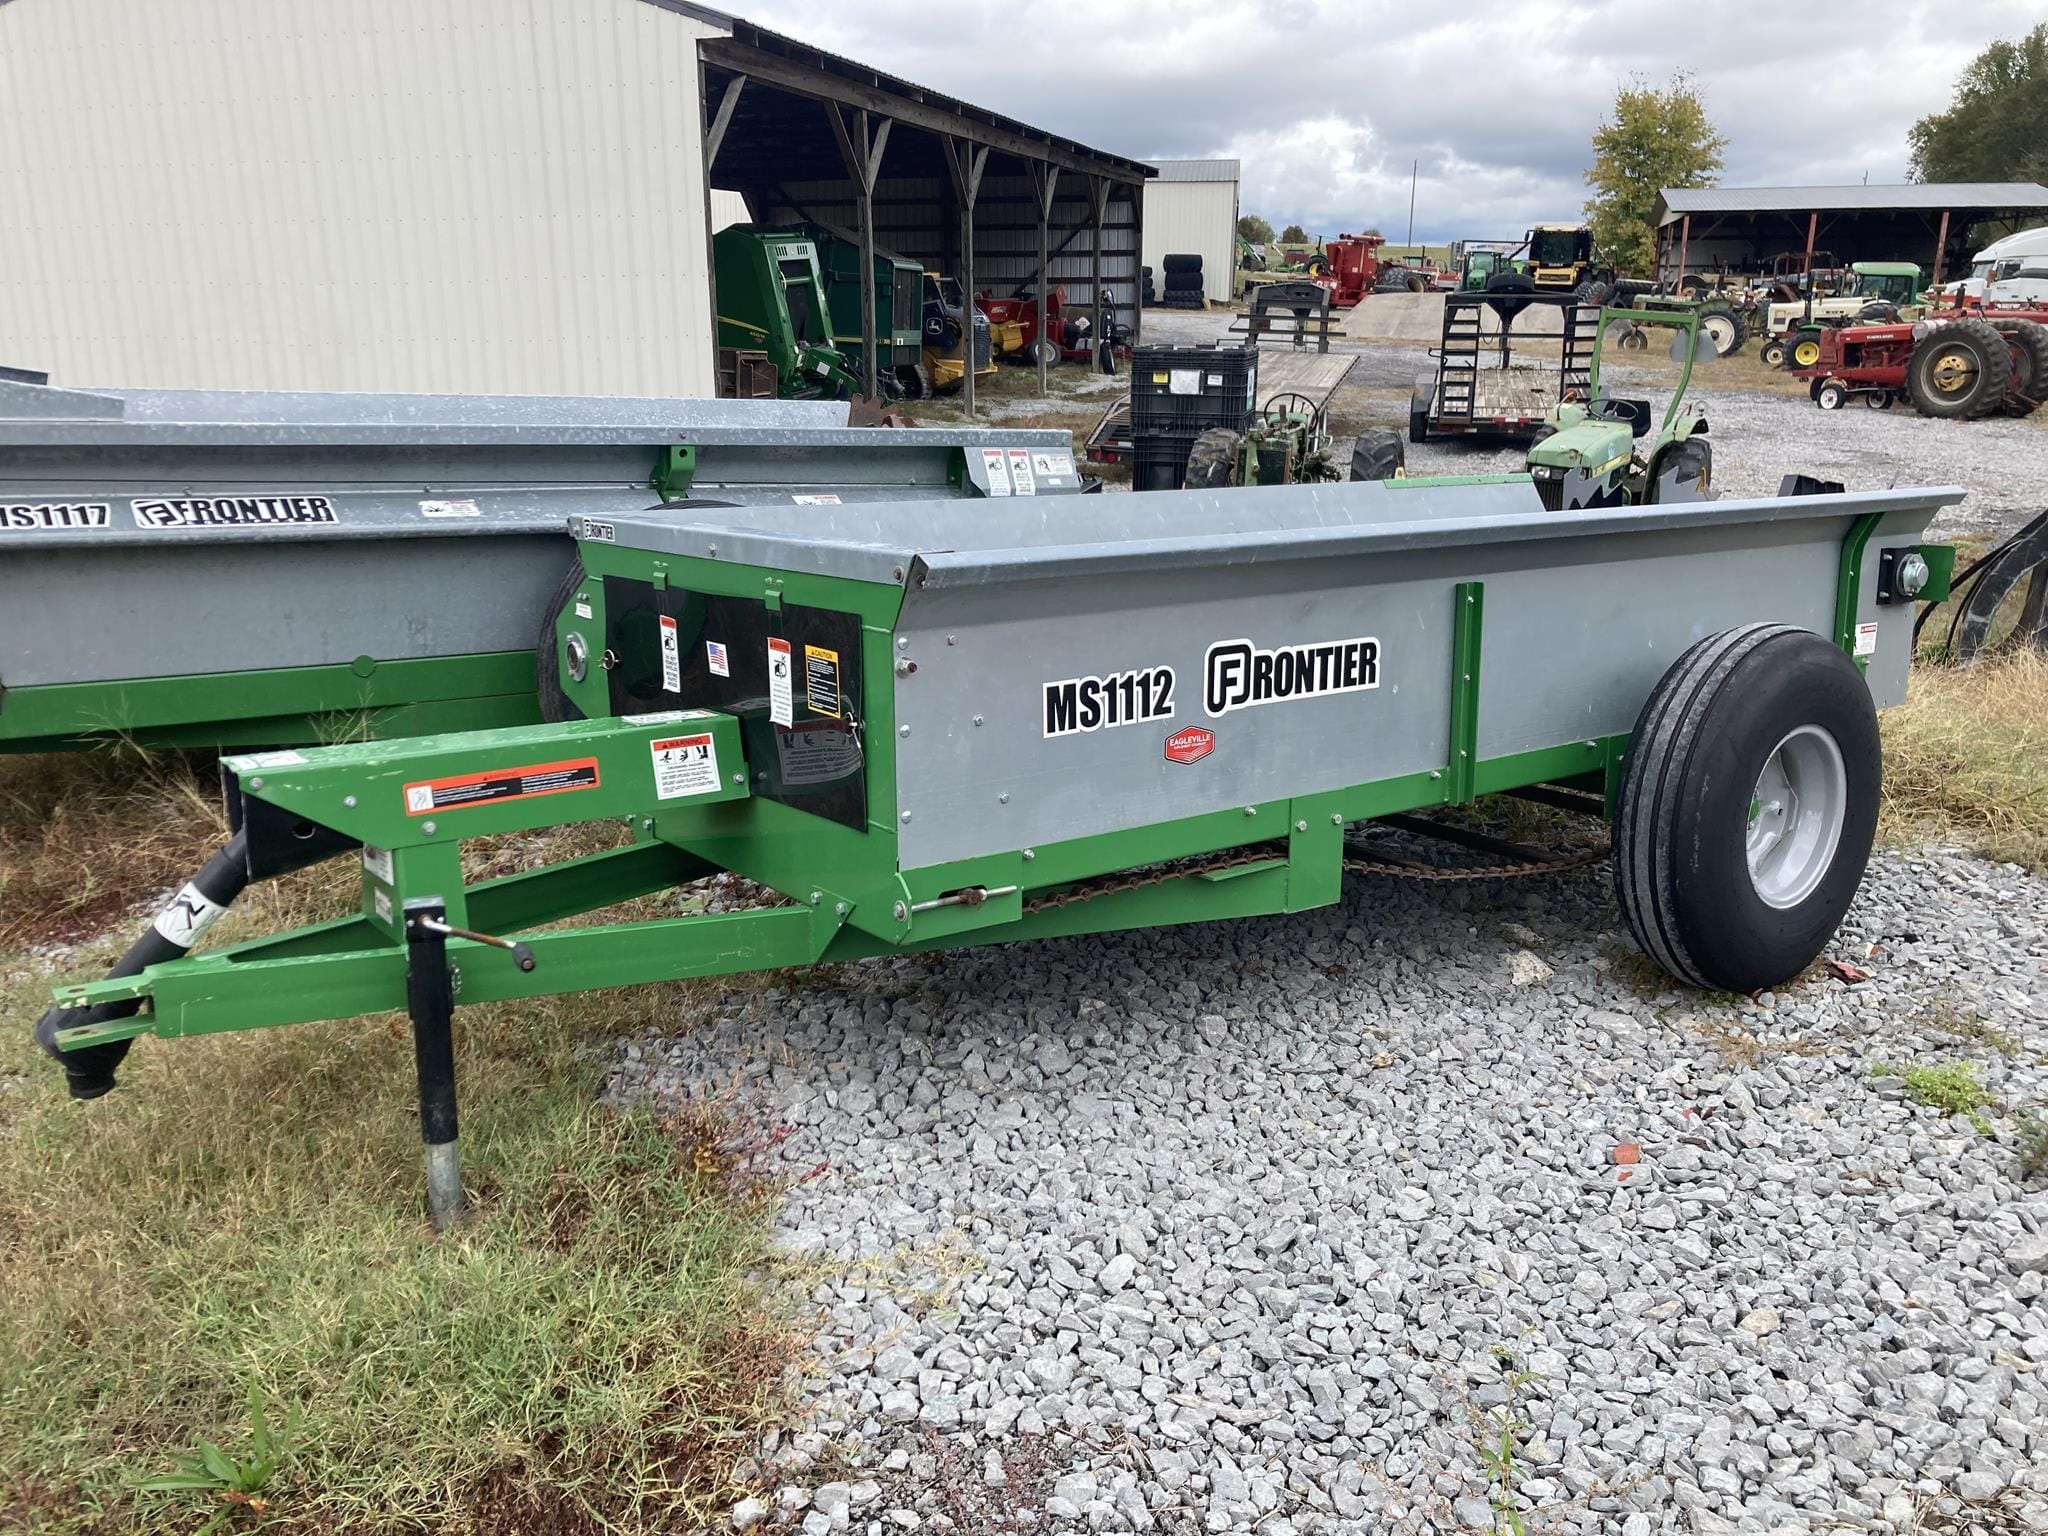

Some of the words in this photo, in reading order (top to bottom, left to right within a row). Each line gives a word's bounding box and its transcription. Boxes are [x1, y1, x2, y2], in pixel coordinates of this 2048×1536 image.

[1046, 669, 1172, 733] MS1112
[1207, 642, 1377, 713] FRONTIER
[1169, 733, 1211, 747] EAGLEVILLE
